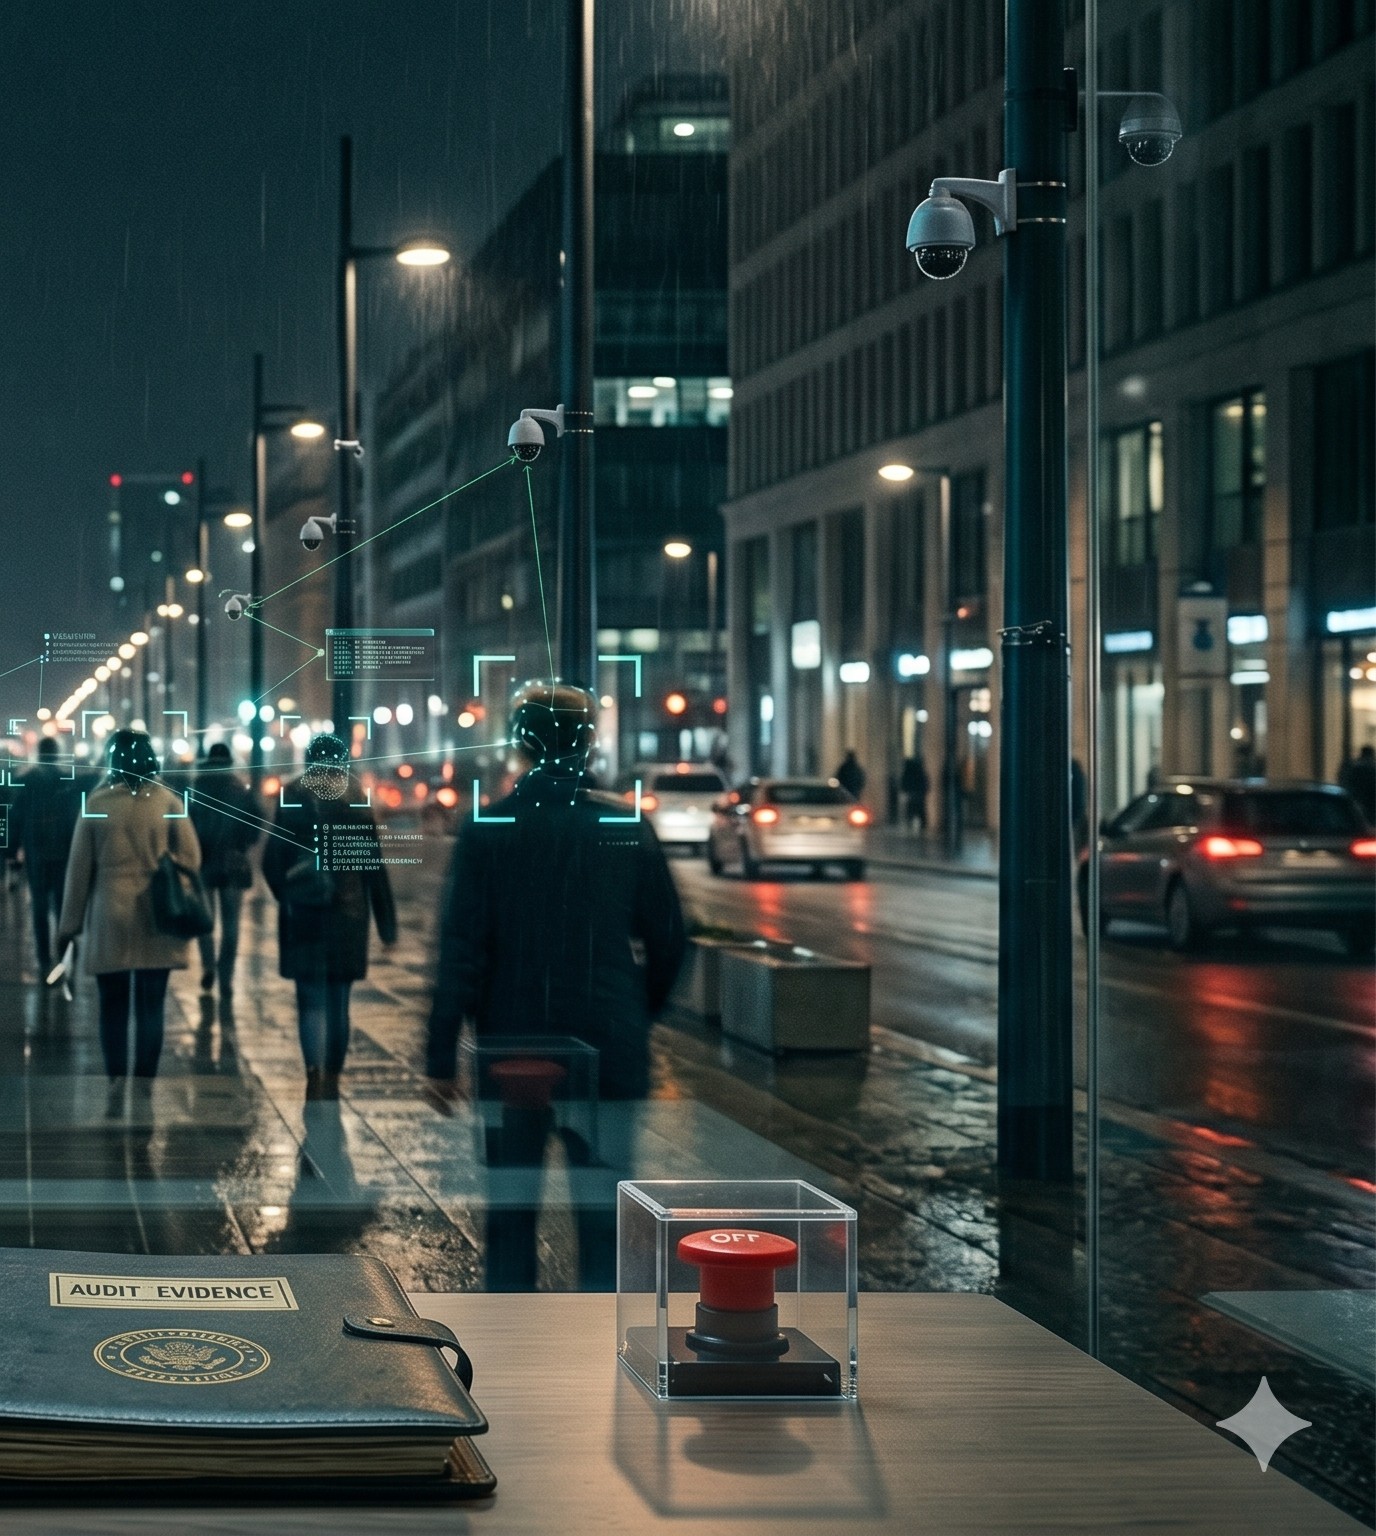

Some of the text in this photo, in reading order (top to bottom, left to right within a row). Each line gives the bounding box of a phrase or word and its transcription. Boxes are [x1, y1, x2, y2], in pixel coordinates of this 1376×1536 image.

[710, 1233, 760, 1244] OFF
[70, 1283, 274, 1299] AUDIT EVIDENCE
